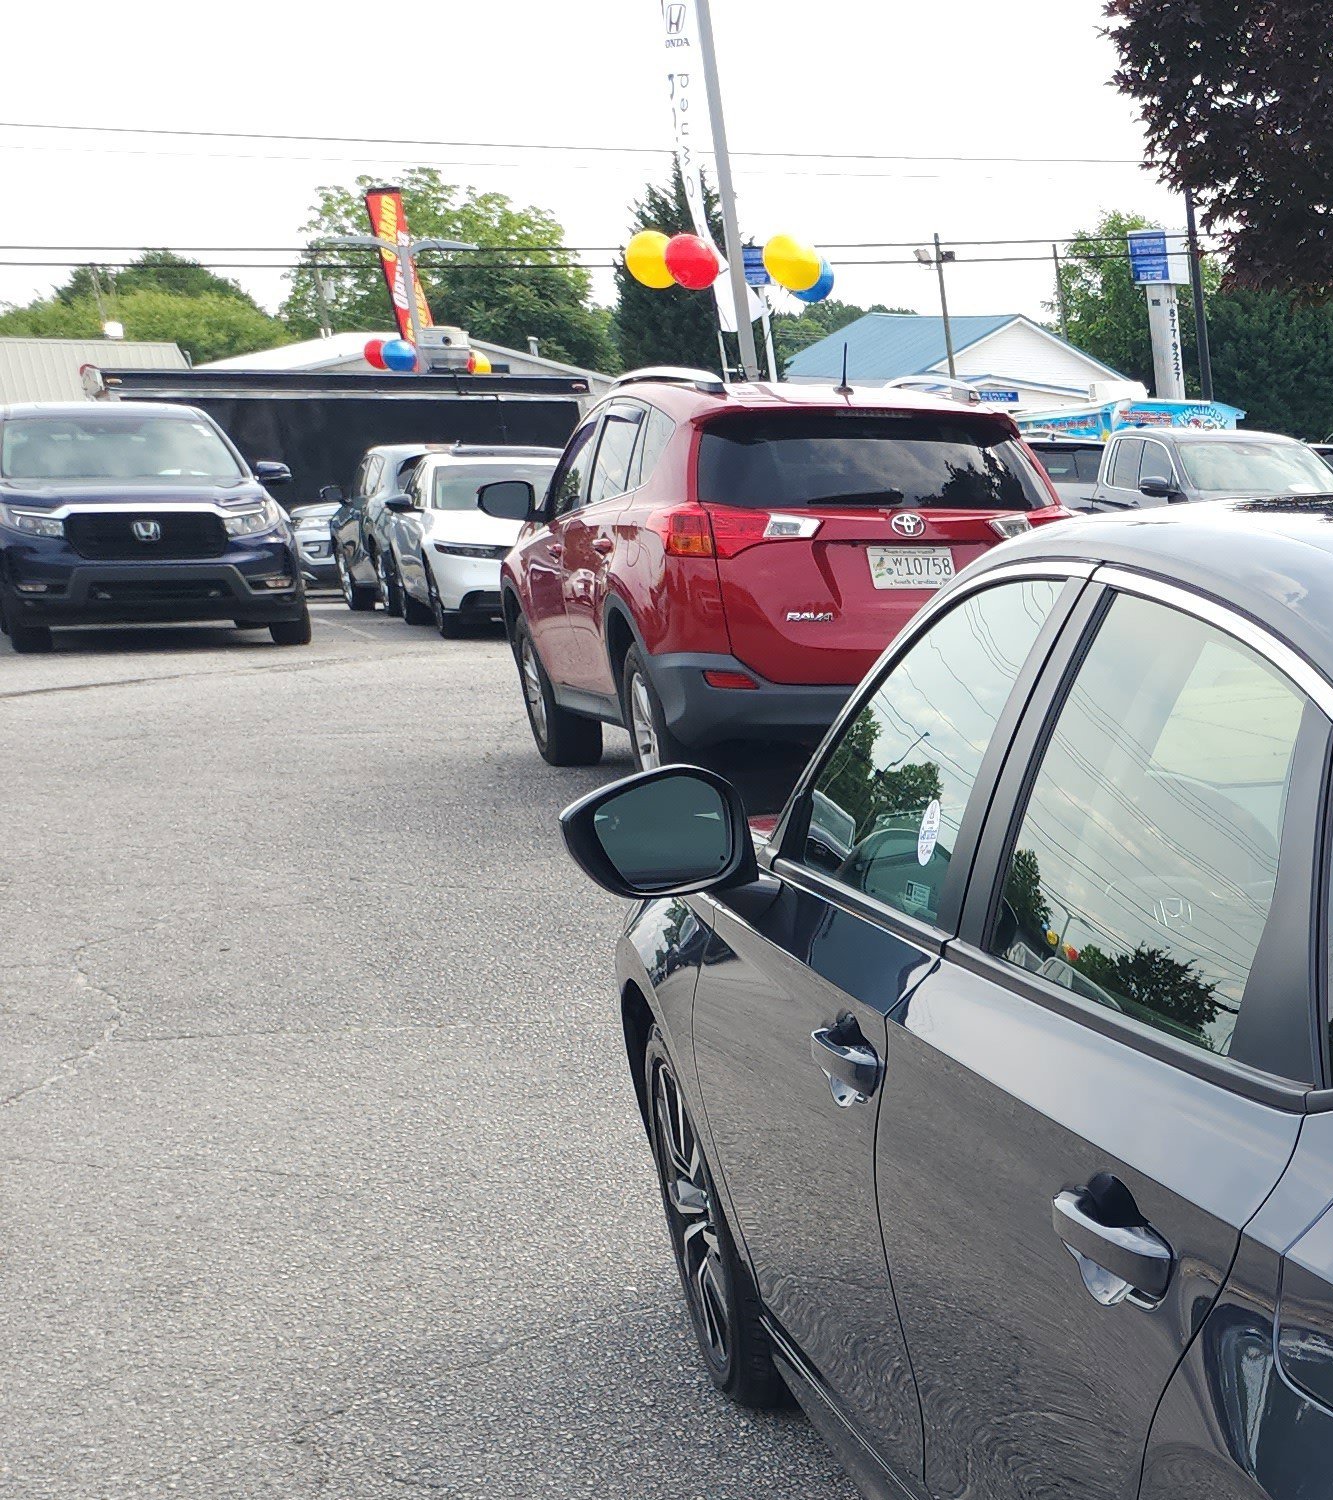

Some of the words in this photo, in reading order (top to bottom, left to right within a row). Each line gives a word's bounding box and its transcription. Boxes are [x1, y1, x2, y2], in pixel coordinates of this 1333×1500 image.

[665, 37, 690, 48] ONDA
[905, 557, 952, 576] 10758
[786, 612, 834, 622] RAV4
